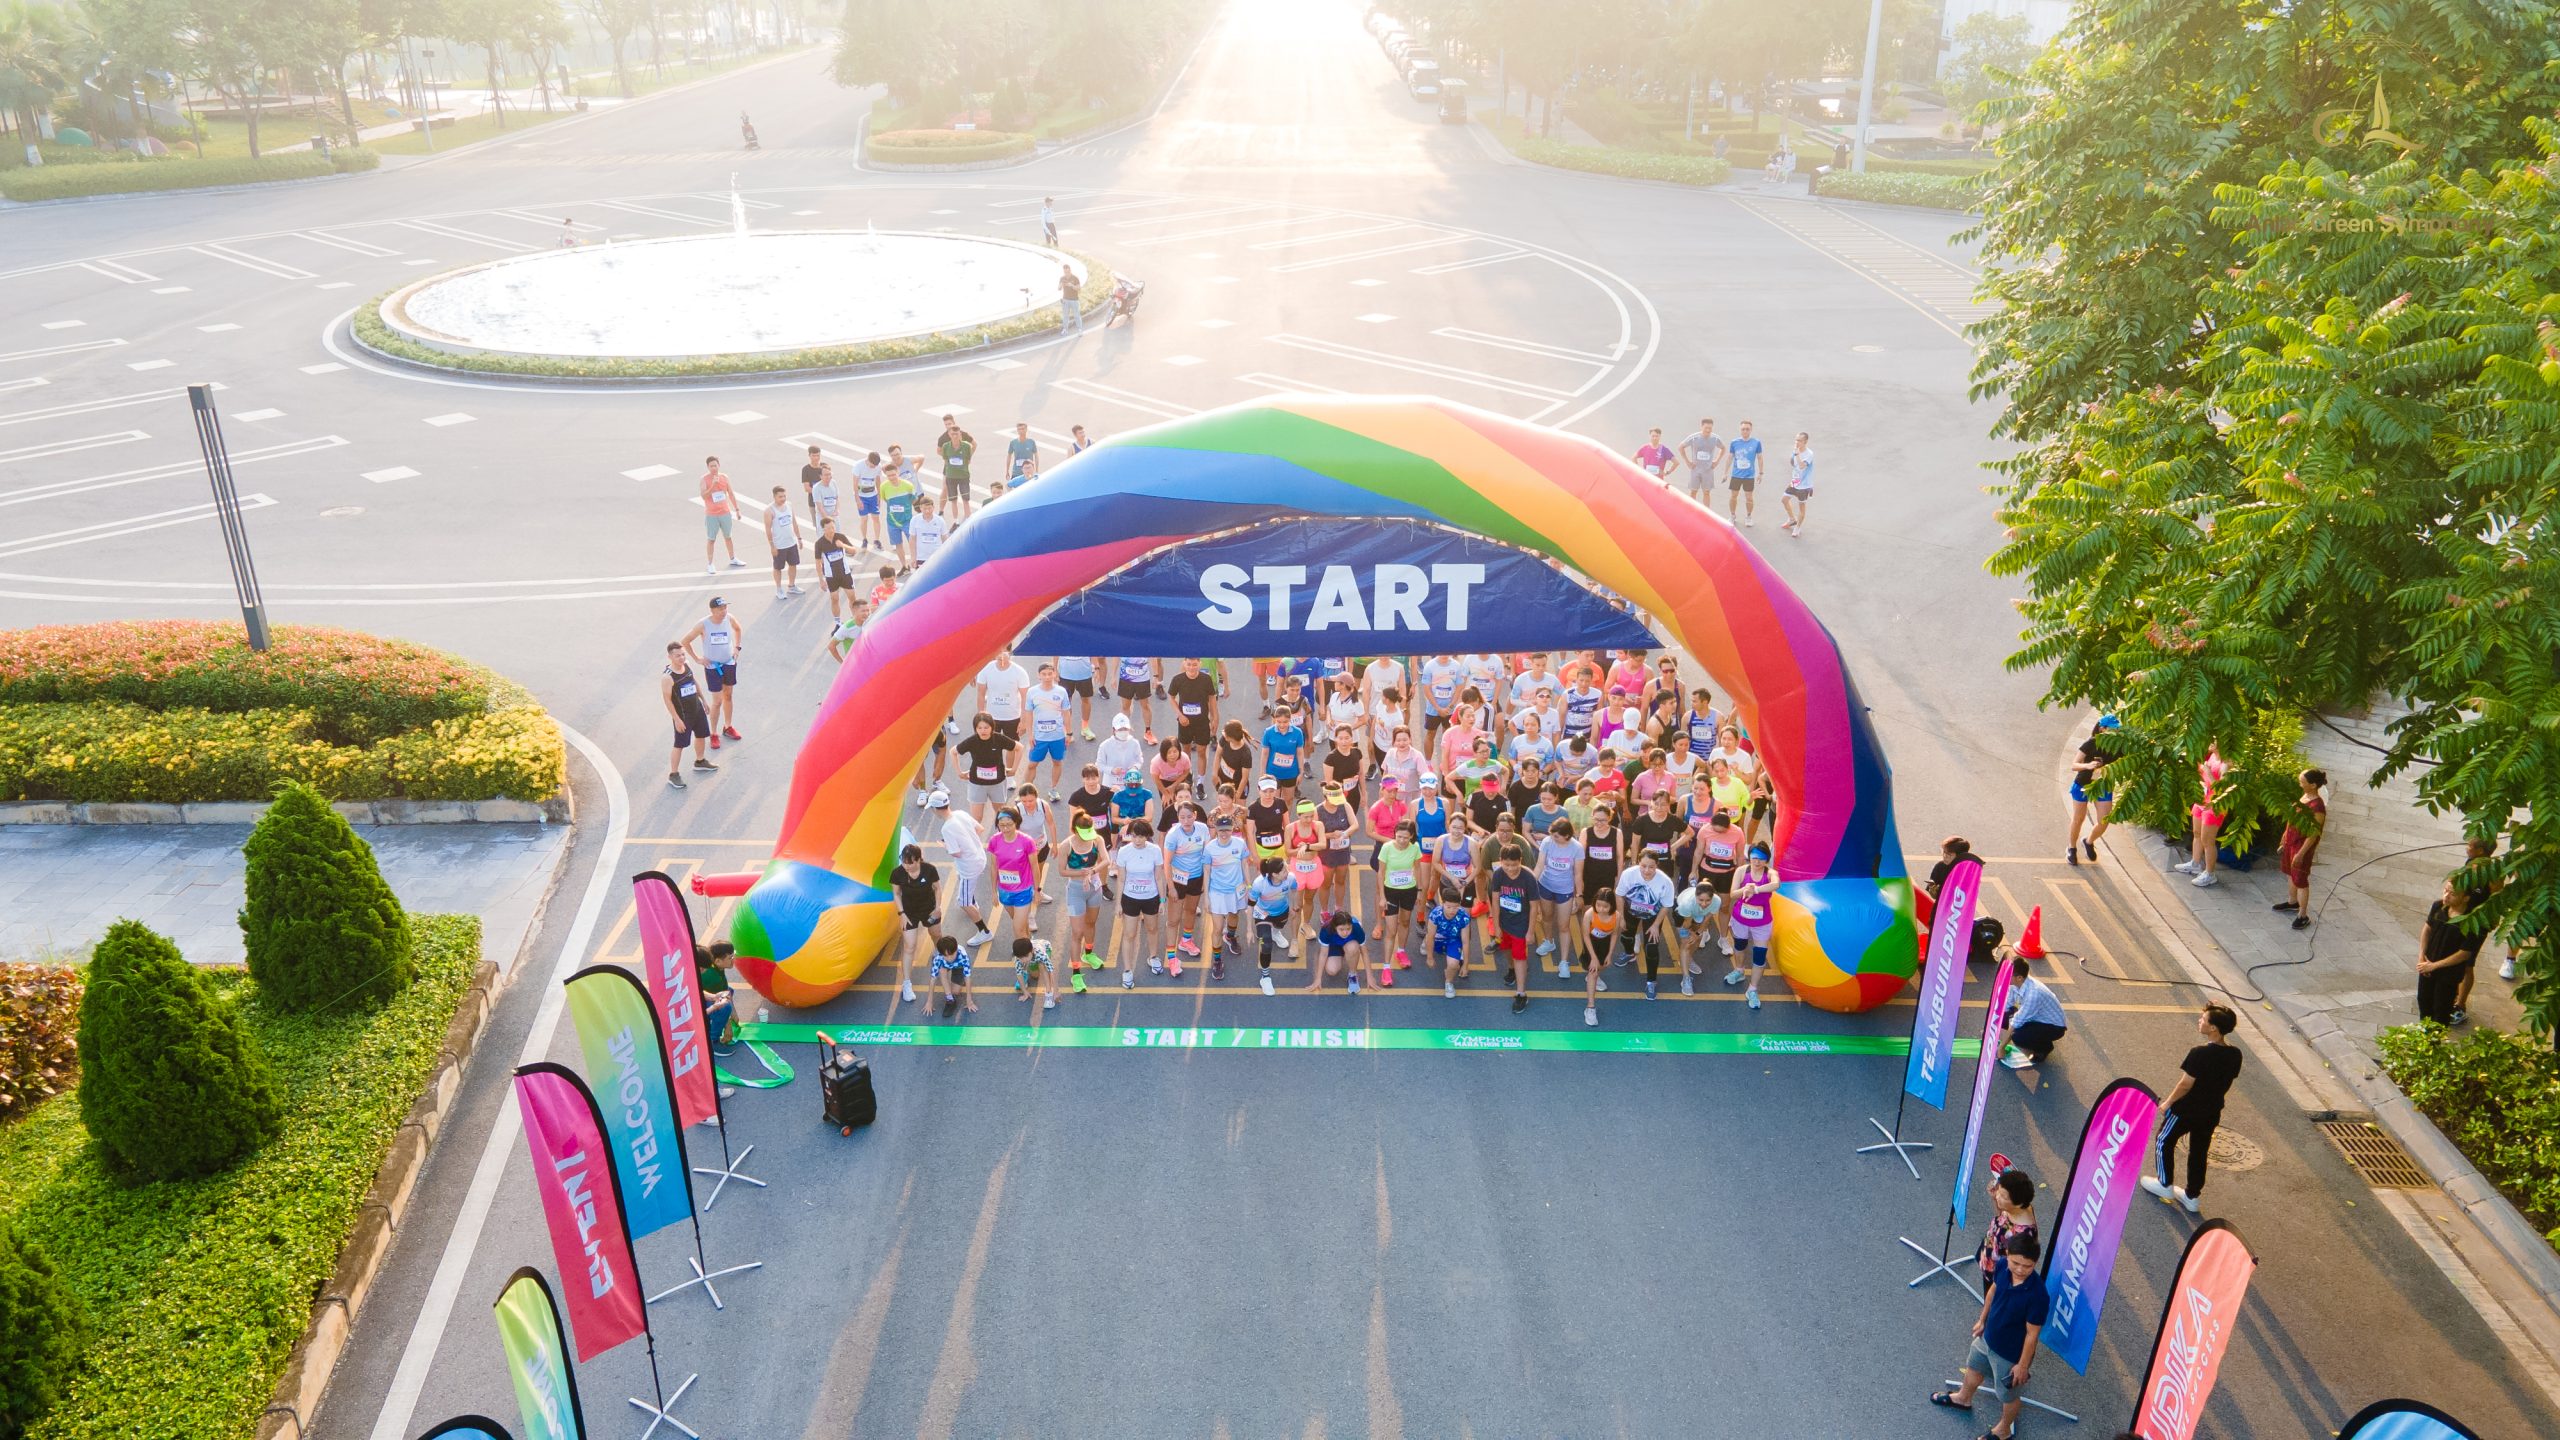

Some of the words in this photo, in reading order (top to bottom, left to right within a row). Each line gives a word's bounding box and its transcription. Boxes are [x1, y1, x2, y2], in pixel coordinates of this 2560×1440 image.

[1197, 564, 1485, 631] START
[662, 949, 699, 1079] EVENT
[1122, 1029, 1217, 1046] START
[1231, 1029, 1246, 1046] /
[1260, 1029, 1366, 1047] FINISH
[1920, 886, 1967, 1084] TEAMBUILDING
[607, 1025, 663, 1199] WELCOME
[2051, 1114, 2130, 1338] TEAMBUILDING
[2190, 1319, 2220, 1405] SUCCESS
